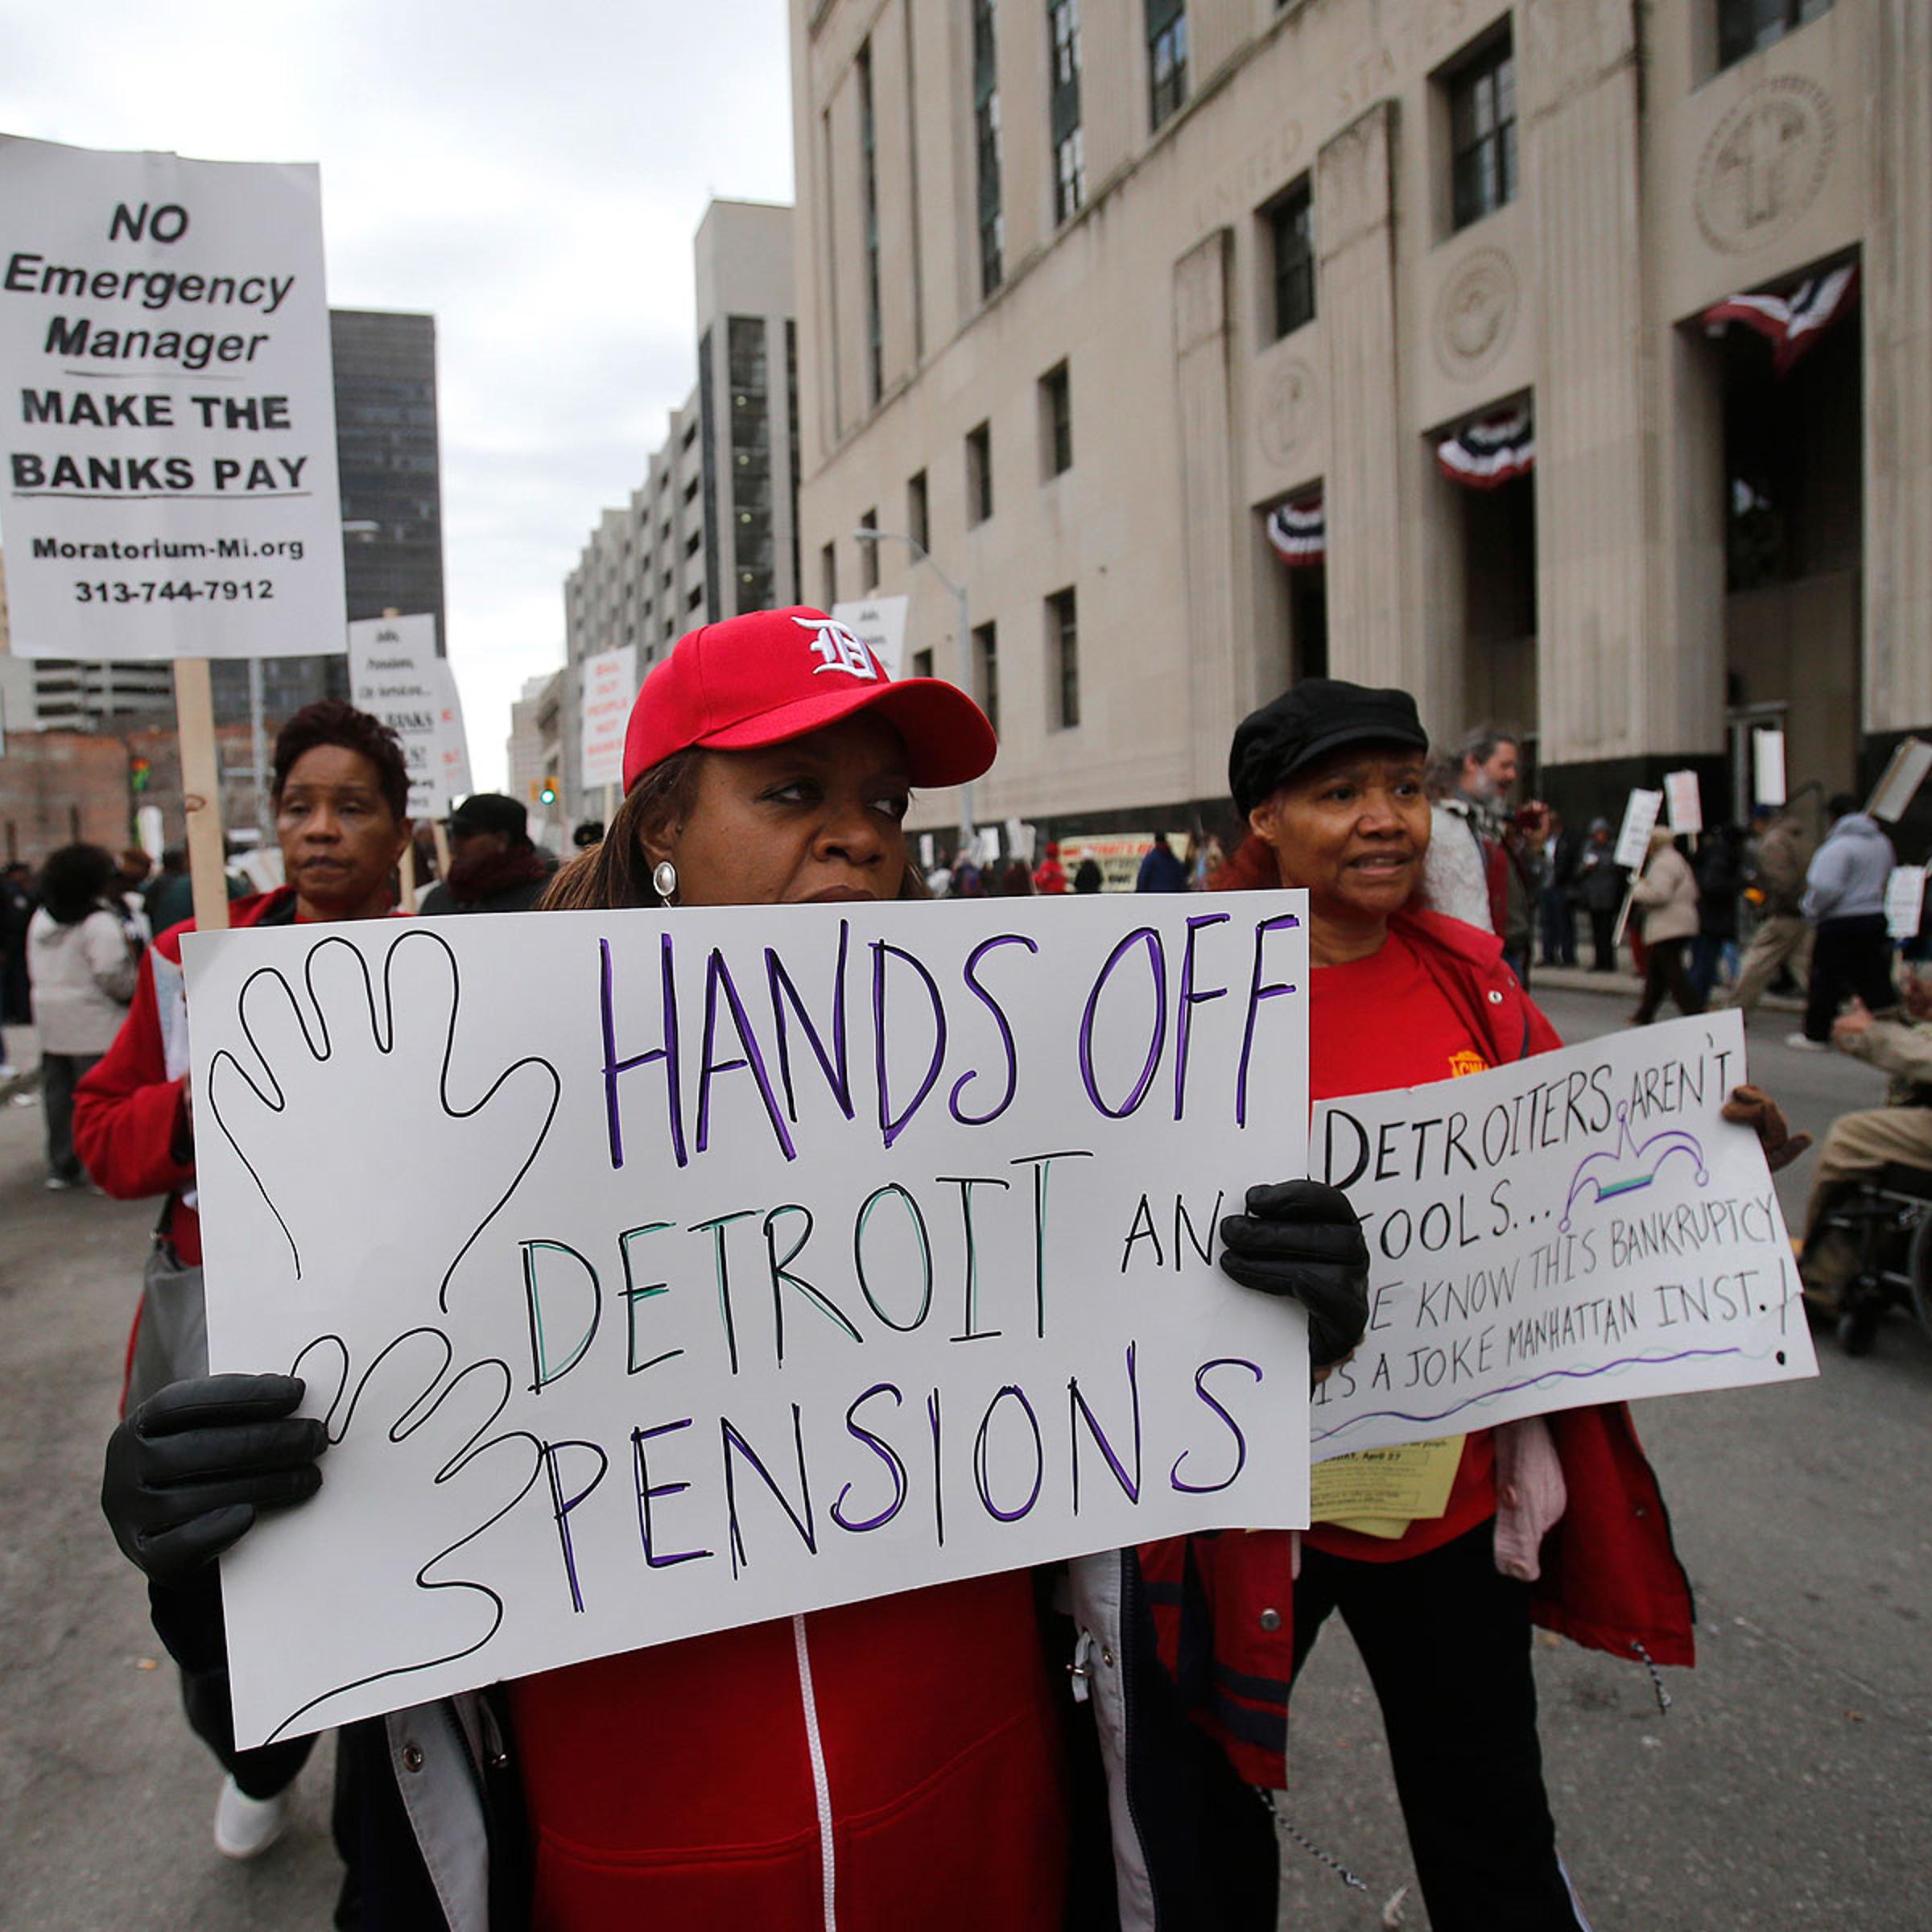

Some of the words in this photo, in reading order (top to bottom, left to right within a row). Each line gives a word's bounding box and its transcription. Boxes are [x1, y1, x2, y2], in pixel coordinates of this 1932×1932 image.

[109, 203, 189, 243] NO
[3, 253, 295, 313] Emergency
[44, 316, 269, 369] Manager
[21, 389, 174, 427] MAKE
[192, 396, 291, 430] THE
[10, 453, 194, 489] BANKS
[214, 456, 308, 489] PAY
[32, 538, 303, 559] Moratorium-Mi.org
[76, 580, 274, 603] 313-744-7912
[598, 919, 1038, 1168] HANDS
[1080, 913, 1300, 1129] OFF
[1324, 1063, 1612, 1191] DETROITERS
[1629, 1033, 1732, 1125] AREN'T
[1357, 1179, 1550, 1260] OOLS...
[518, 1151, 1094, 1394] DETROIT
[1122, 1191, 1224, 1272] AN
[1366, 1281, 1404, 1331] E
[1416, 1257, 1521, 1327] KNOW
[1530, 1228, 1596, 1290] THIS
[1612, 1193, 1777, 1269] BANKRUPTCY
[1372, 1352, 1391, 1391] A
[1404, 1325, 1496, 1388] JOKE
[1506, 1290, 1639, 1367] MANHATTAN
[539, 1340, 1264, 1612] PENSIONS
